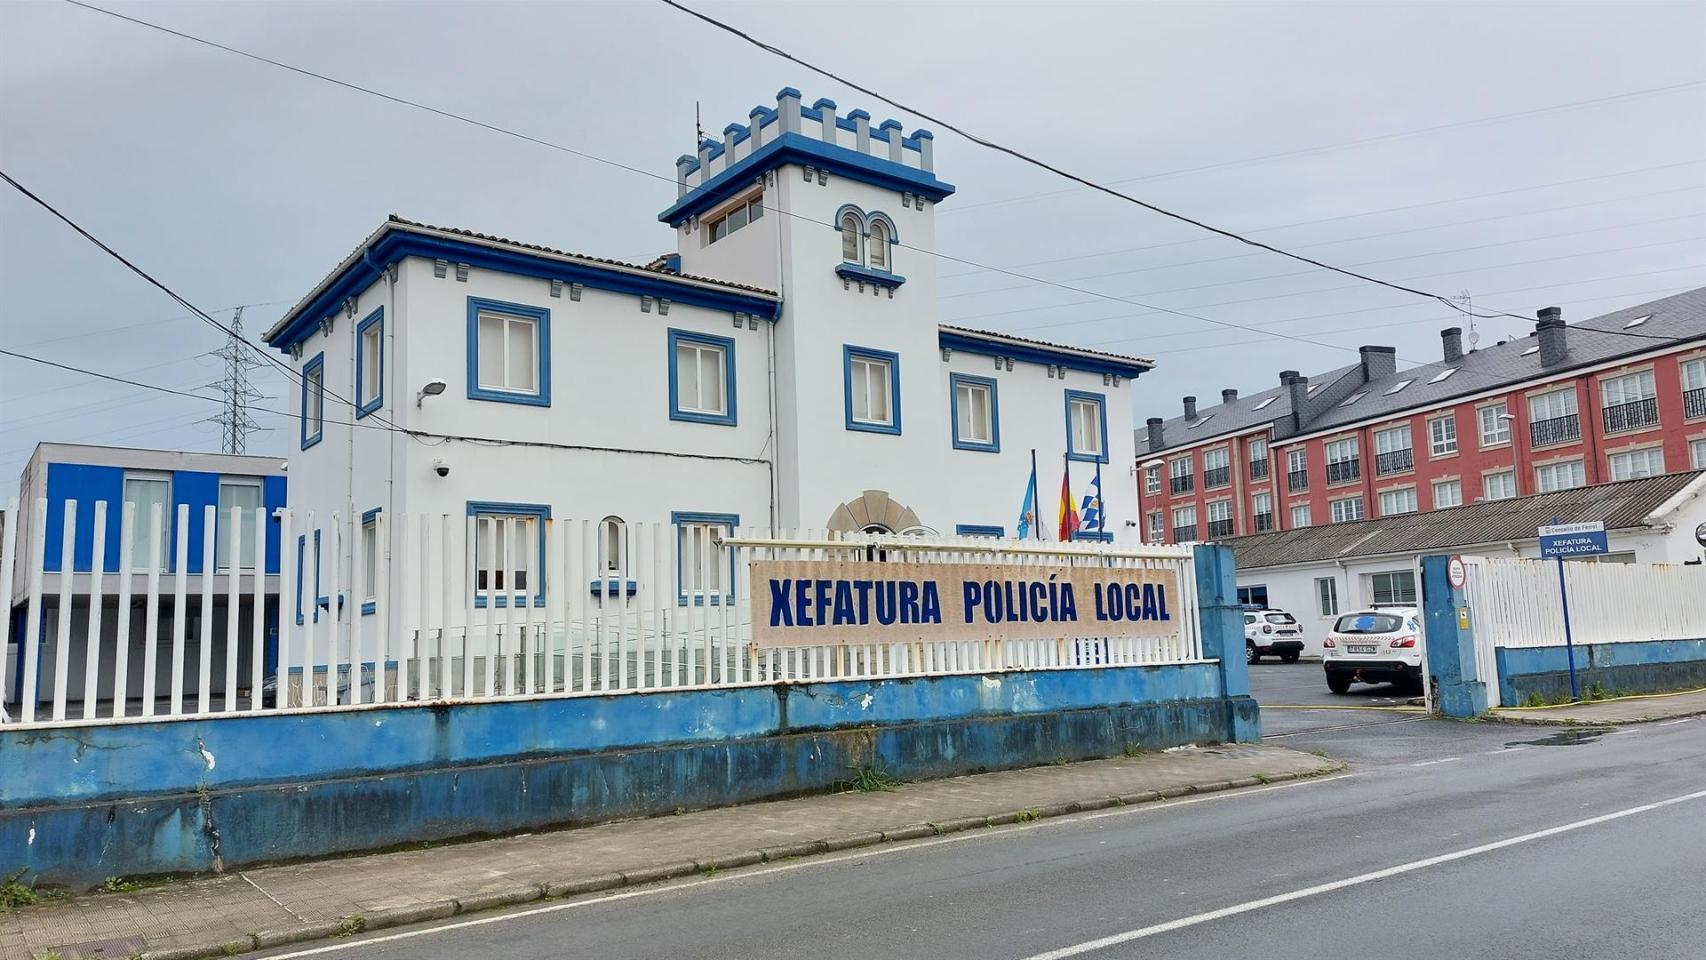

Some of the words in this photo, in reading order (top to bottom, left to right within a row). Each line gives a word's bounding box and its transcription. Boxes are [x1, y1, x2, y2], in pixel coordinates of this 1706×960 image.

[1553, 538, 1592, 547] XEFATURA
[1545, 546, 1575, 554] POLICÍA
[1576, 544, 1603, 552] LOCAL
[769, 578, 942, 627] XEFATURA
[964, 573, 1078, 624] POLICÍA
[1095, 582, 1170, 622] LOCAL
